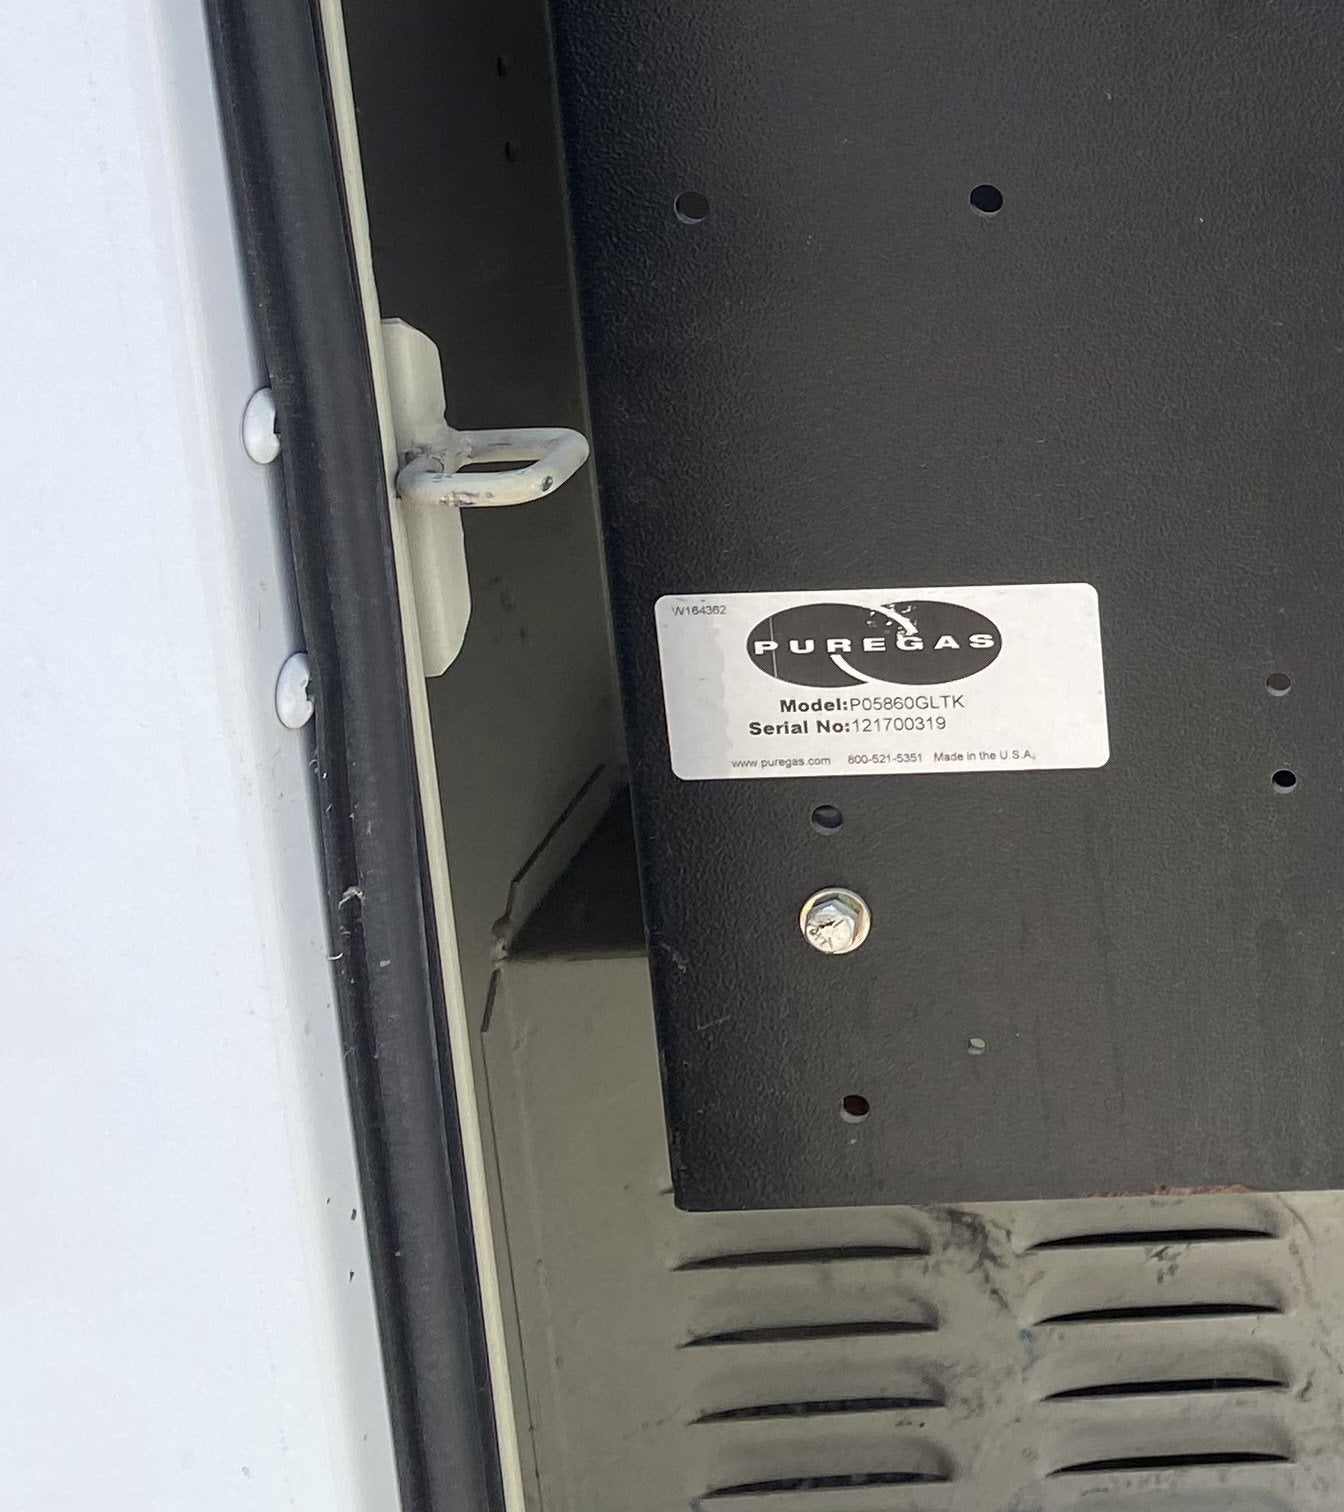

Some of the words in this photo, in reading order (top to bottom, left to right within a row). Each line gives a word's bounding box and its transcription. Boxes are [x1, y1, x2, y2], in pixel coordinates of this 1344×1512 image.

[753, 633, 995, 655] PUREGAS
[749, 720, 808, 736] Serial
[848, 752, 922, 764] 800-521-5351
[934, 752, 964, 762] Made
[966, 750, 976, 762] in
[979, 750, 996, 761] the
